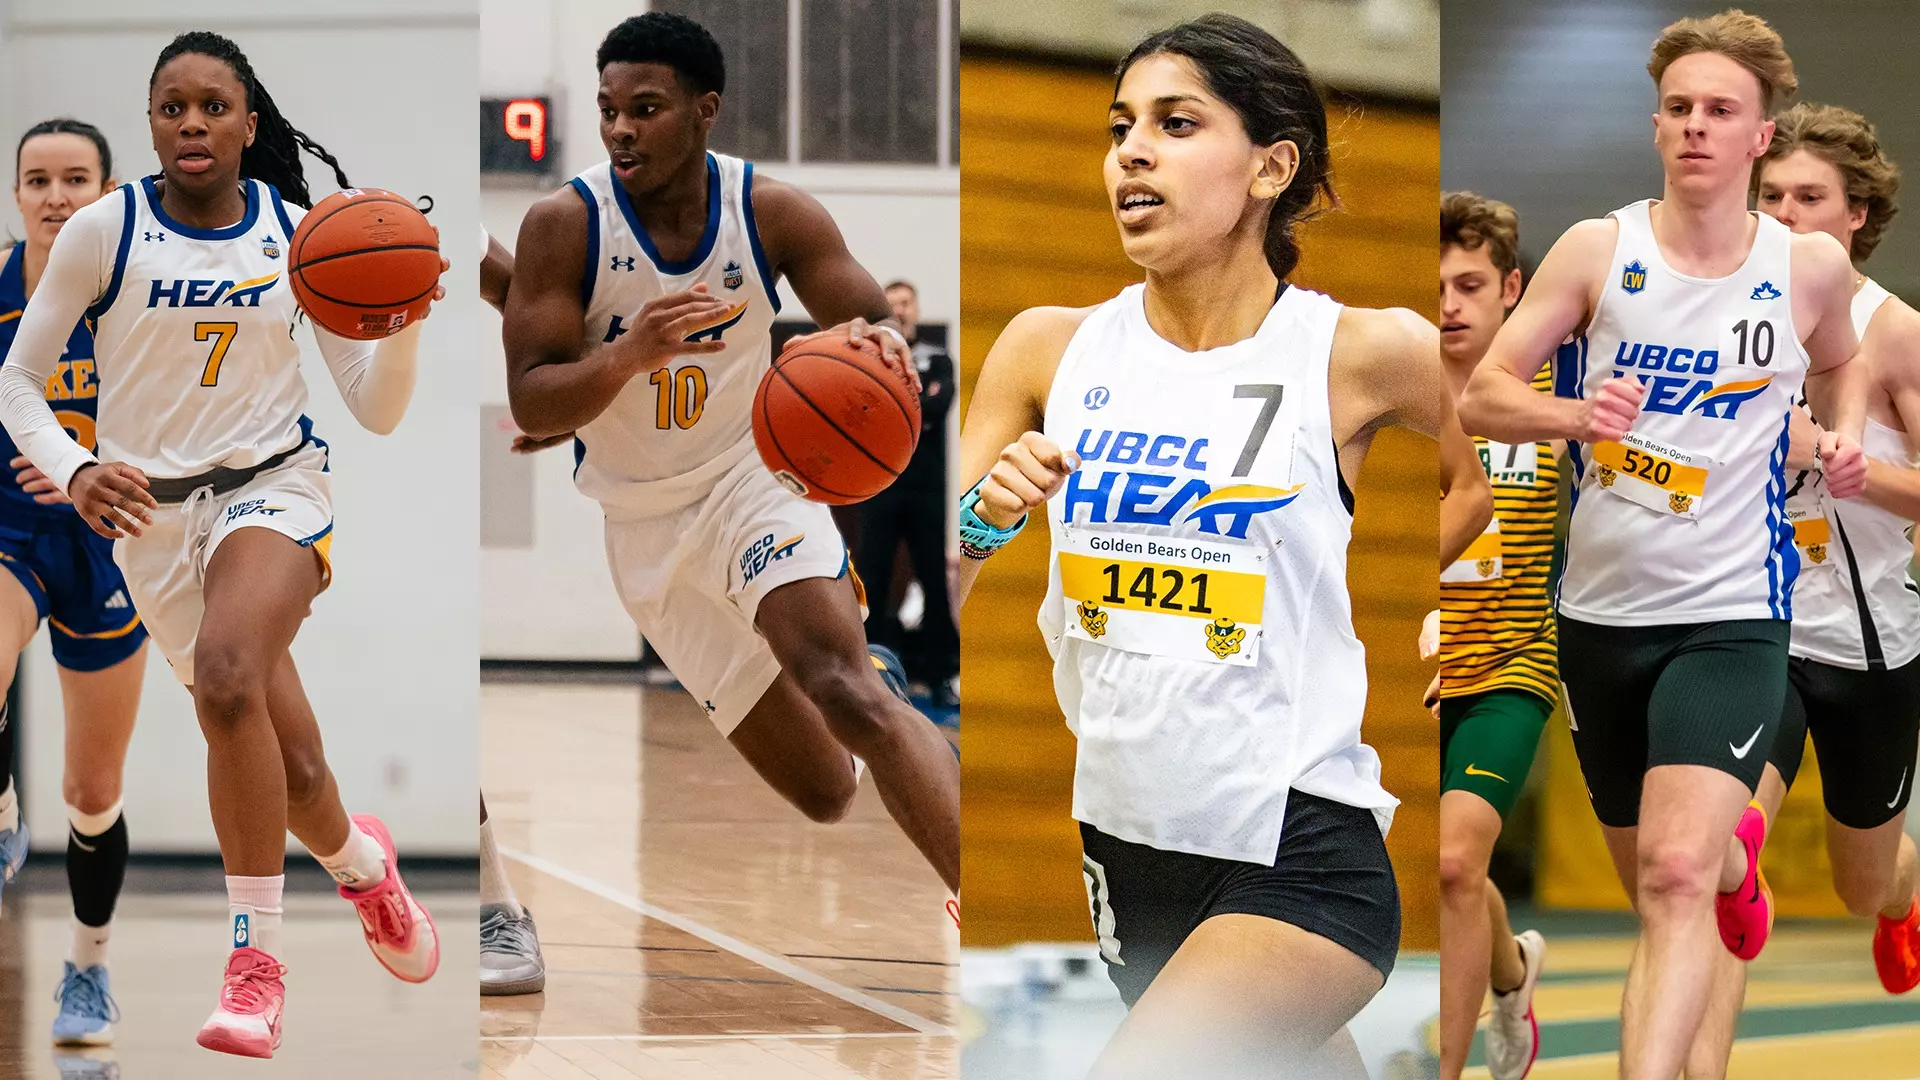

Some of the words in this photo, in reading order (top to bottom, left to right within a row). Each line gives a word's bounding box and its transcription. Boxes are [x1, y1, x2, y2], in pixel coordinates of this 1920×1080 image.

[503, 98, 546, 161] 9
[146, 271, 280, 308] HEAT
[1623, 271, 1645, 289] CW
[193, 321, 239, 387] 7
[1614, 341, 1719, 375] UBCO
[1731, 319, 1775, 368] 10
[649, 365, 709, 430] 10
[1231, 383, 1284, 478] 7
[1622, 449, 1672, 485] 520
[1644, 440, 1668, 455] Bears
[1669, 448, 1692, 462] Open
[225, 505, 289, 527] HEAT
[1064, 470, 1306, 540] HEAT
[1788, 509, 1807, 519] Open
[740, 533, 774, 571] UBCO
[742, 533, 805, 592] HEAT
[1089, 536, 1143, 554] Golden
[1149, 541, 1187, 559] Bears
[1191, 547, 1231, 564] Open
[1102, 563, 1213, 615] 1421
